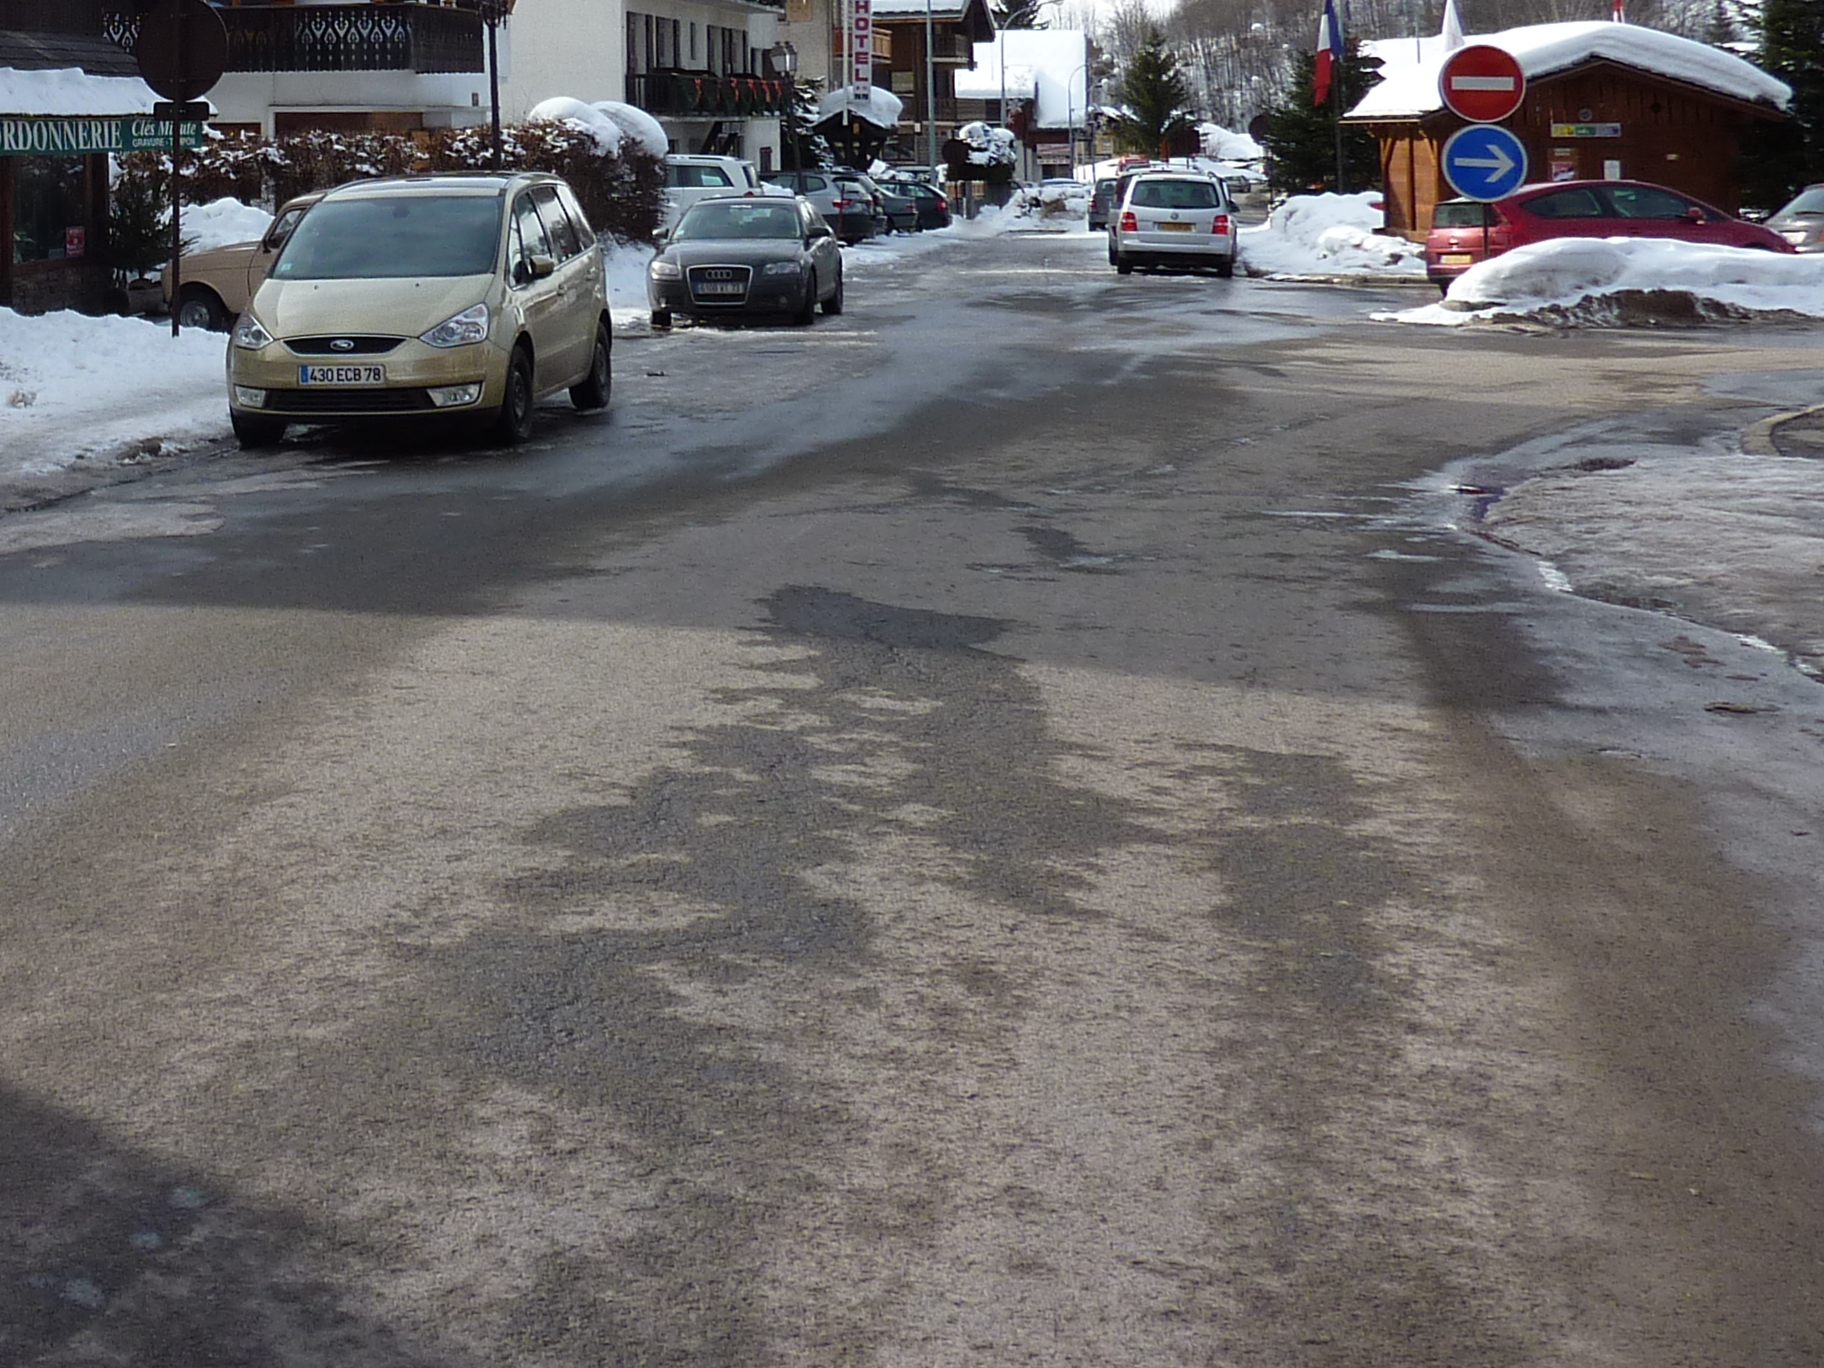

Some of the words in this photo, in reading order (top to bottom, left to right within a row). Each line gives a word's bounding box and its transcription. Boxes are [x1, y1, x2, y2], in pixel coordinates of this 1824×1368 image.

[855, 0, 870, 82] HOTEL
[158, 120, 197, 136] Miute
[310, 368, 334, 382] 430
[336, 368, 362, 382] ECB
[364, 368, 381, 382] 78
